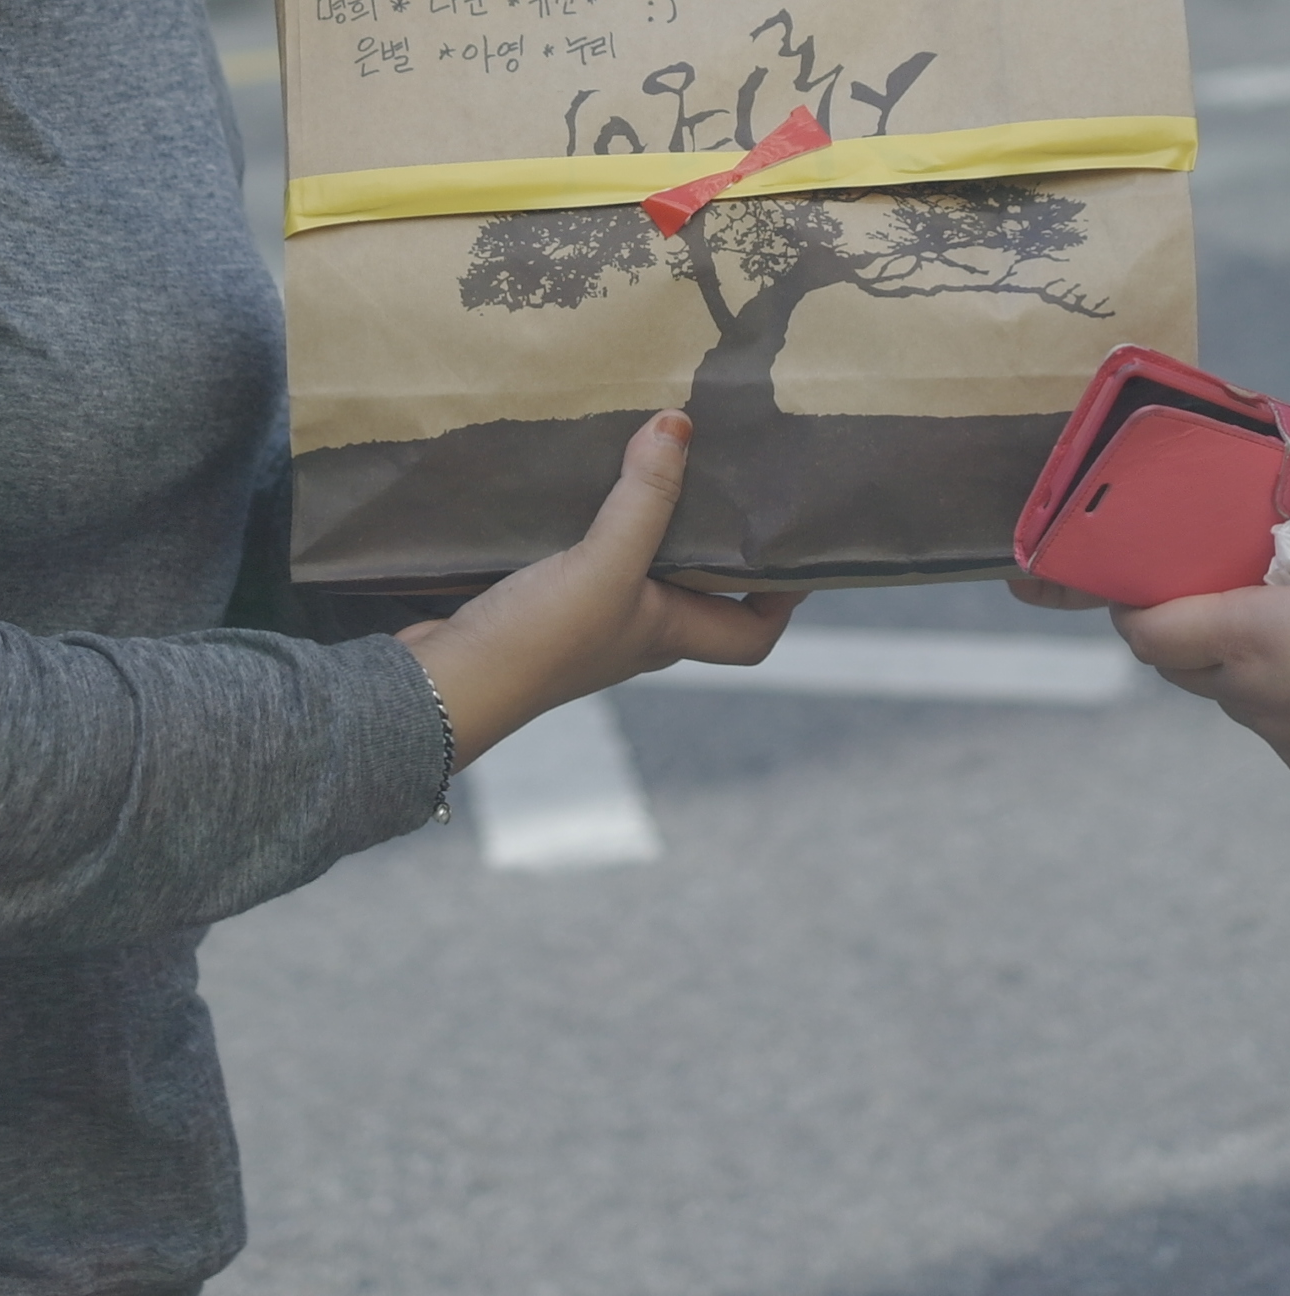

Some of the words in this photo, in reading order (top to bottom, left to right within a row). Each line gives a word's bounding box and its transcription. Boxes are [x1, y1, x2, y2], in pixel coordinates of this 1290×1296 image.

[354, 35, 414, 78] 은별
[461, 33, 524, 74] 아영
[565, 31, 617, 66] 누리
